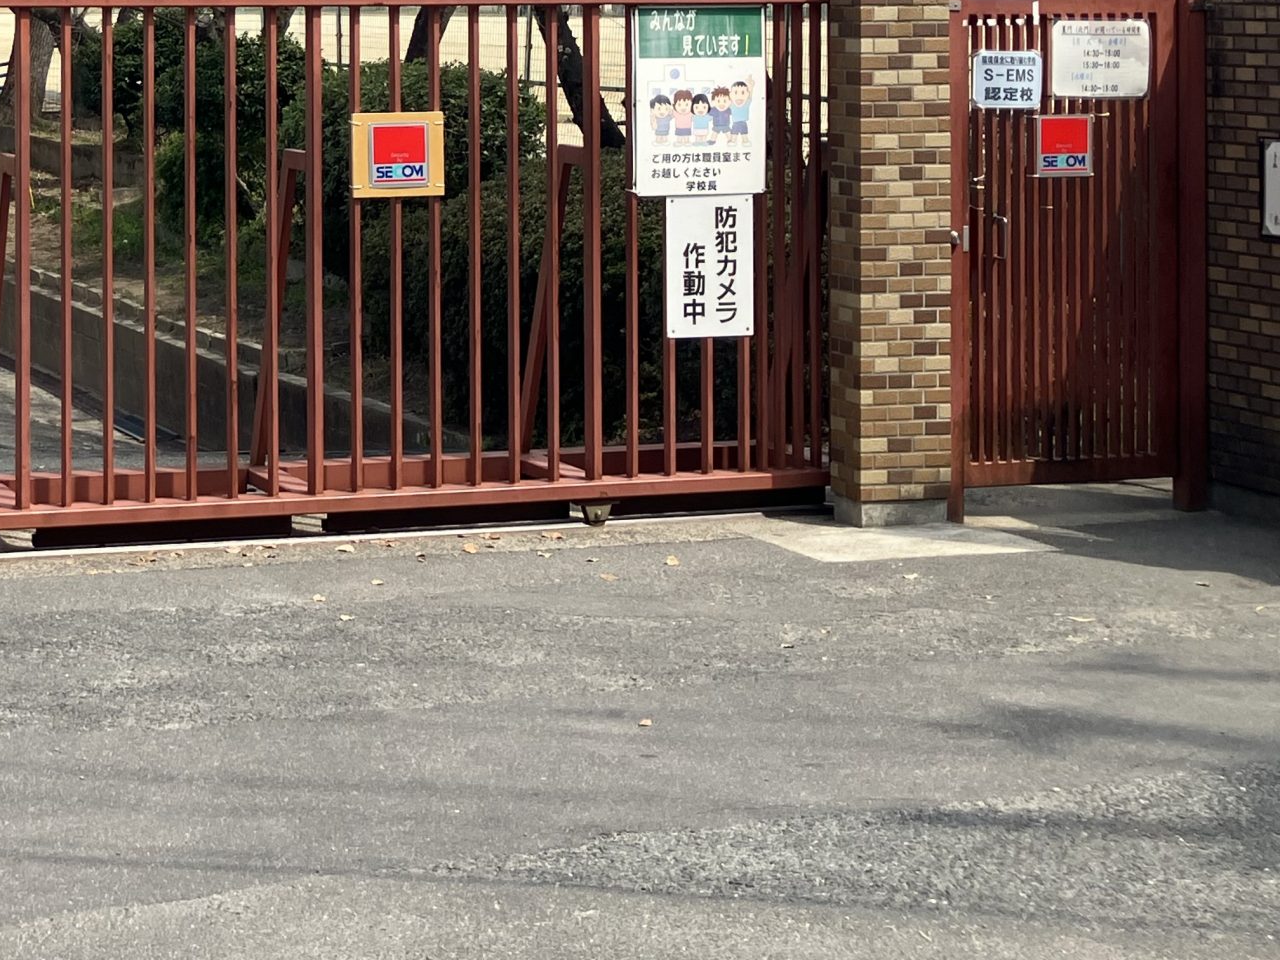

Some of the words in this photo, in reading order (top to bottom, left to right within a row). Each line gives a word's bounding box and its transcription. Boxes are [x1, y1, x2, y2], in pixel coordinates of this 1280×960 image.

[649, 10, 697, 31] みんなが
[682, 33, 750, 57] 見ています！
[983, 68, 1034, 82] S-EMS
[984, 86, 1034, 102] 認定校
[651, 151, 752, 164] ご用の方は職員室まで
[1043, 155, 1086, 168] SECOM
[376, 164, 423, 179] SECOM
[651, 167, 721, 179] お越しください
[686, 180, 717, 191] 学校長
[714, 205, 738, 324] 防犯カメラ
[682, 242, 706, 325] 作動中
